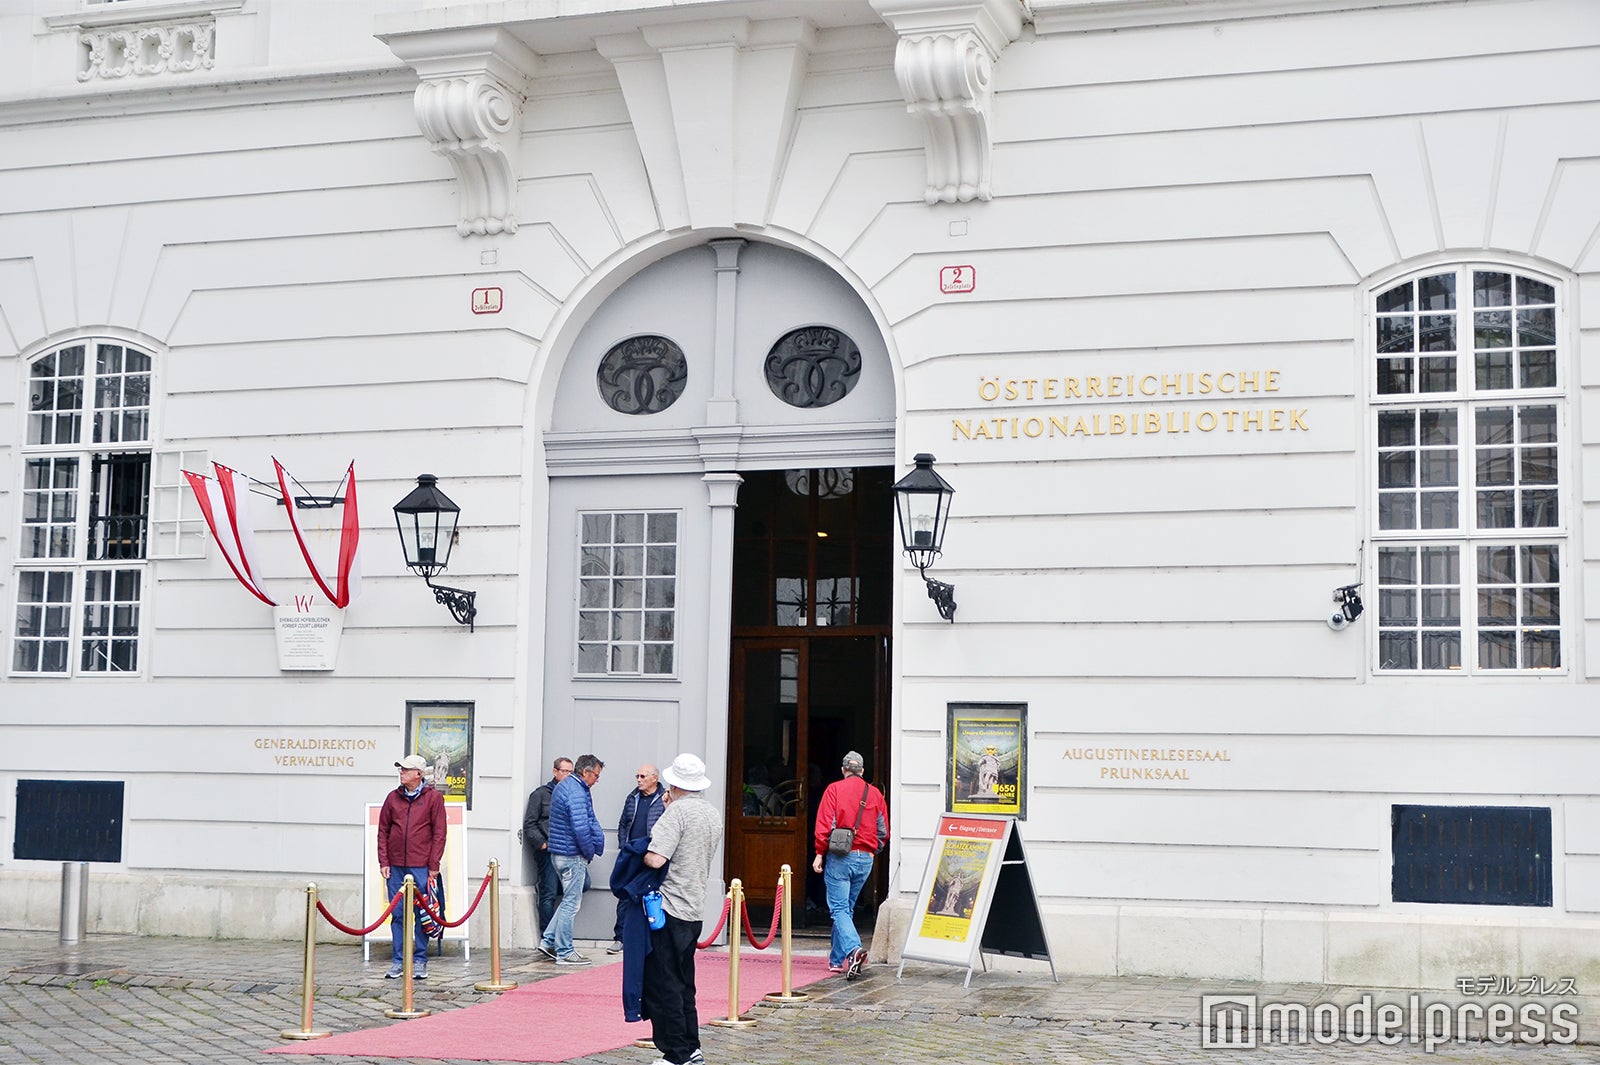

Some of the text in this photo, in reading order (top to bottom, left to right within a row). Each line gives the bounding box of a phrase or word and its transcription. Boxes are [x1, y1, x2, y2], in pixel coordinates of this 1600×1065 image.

[953, 268, 962, 283] 2
[484, 291, 489, 304] 1
[978, 370, 1281, 402] ÖSTERREICHISCHE
[952, 408, 1310, 441] NATIONALBIBLIOTHEK
[254, 738, 376, 750] GENERALDIREKTION
[275, 755, 355, 767] VERWALTUNG
[1062, 748, 1231, 762] AUGUSTINERLESESAAL
[1100, 767, 1190, 780] PRUNKSAAL
[451, 777, 466, 785] 650
[999, 784, 1015, 792] 650
